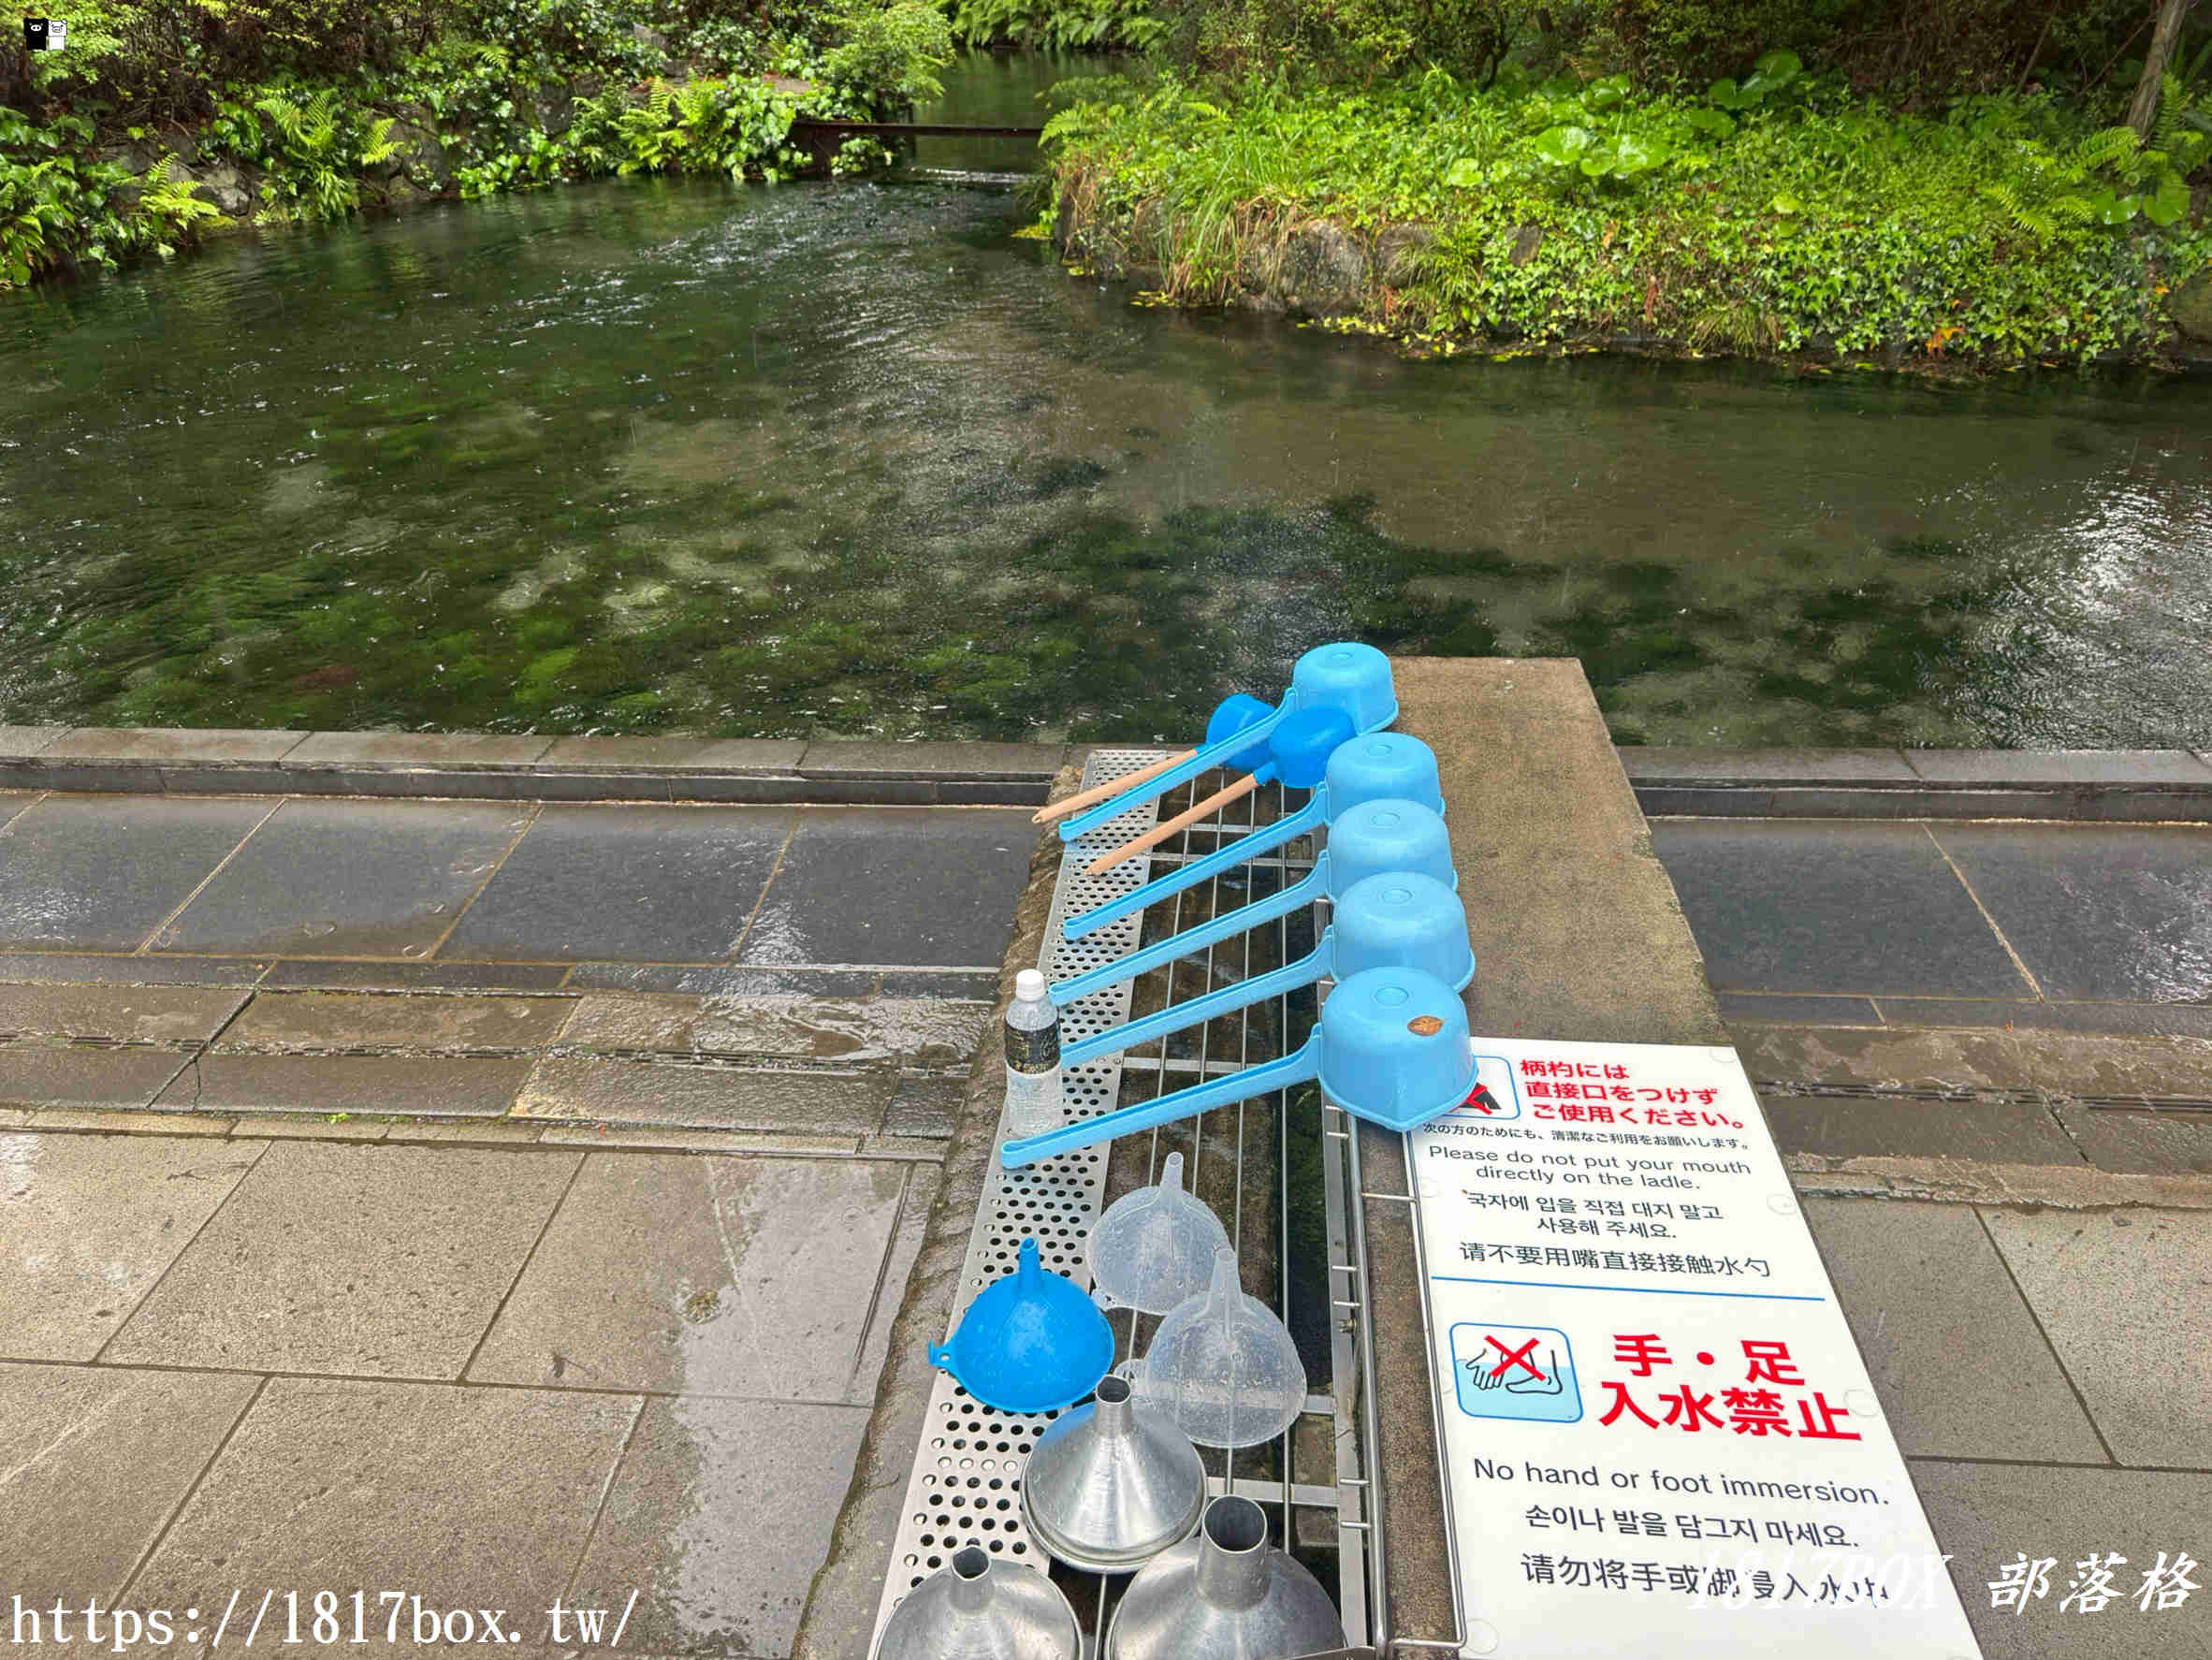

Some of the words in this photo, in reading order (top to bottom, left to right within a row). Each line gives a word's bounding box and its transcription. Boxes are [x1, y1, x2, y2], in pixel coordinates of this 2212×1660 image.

[1520, 1059, 1629, 1079] 柄杓には
[1524, 1081, 1718, 1105] 直接口をつけず
[1532, 1103, 1744, 1129] ご使用ください。
[1429, 1145, 1498, 1162] Please
[1506, 1149, 1534, 1164] do
[1541, 1152, 1575, 1167] not
[1583, 1155, 1619, 1171] put
[1626, 1158, 1674, 1172] your
[1682, 1160, 1752, 1174] mouth
[1476, 1165, 1554, 1185] directly
[1563, 1172, 1591, 1185] on
[1598, 1172, 1634, 1187] the
[1640, 1174, 1700, 1191] ladle.
[1466, 1192, 1529, 1212] 국자에
[1535, 1196, 1577, 1215] 입을
[1583, 1199, 1625, 1217] 직접
[1632, 1201, 1674, 1219] 대지
[1680, 1203, 1724, 1221] 말고
[1536, 1217, 1600, 1236] 사용해
[1606, 1221, 1677, 1239] 주세요.
[1460, 1242, 1770, 1277] 请不要用嘴直接接触水勺
[1598, 1381, 1862, 1442] 入水禁止
[1474, 1458, 1514, 1480] No
[1525, 1462, 1600, 1486] hand
[1611, 1471, 1640, 1489] or
[1650, 1470, 1713, 1494] foot
[1720, 1474, 1890, 1506] immersion.
[1525, 1504, 1605, 1533] 손이나
[1612, 1509, 1668, 1536] 발을
[1675, 1514, 1758, 1543] 담그지
[1766, 1520, 1860, 1548] 마세요.
